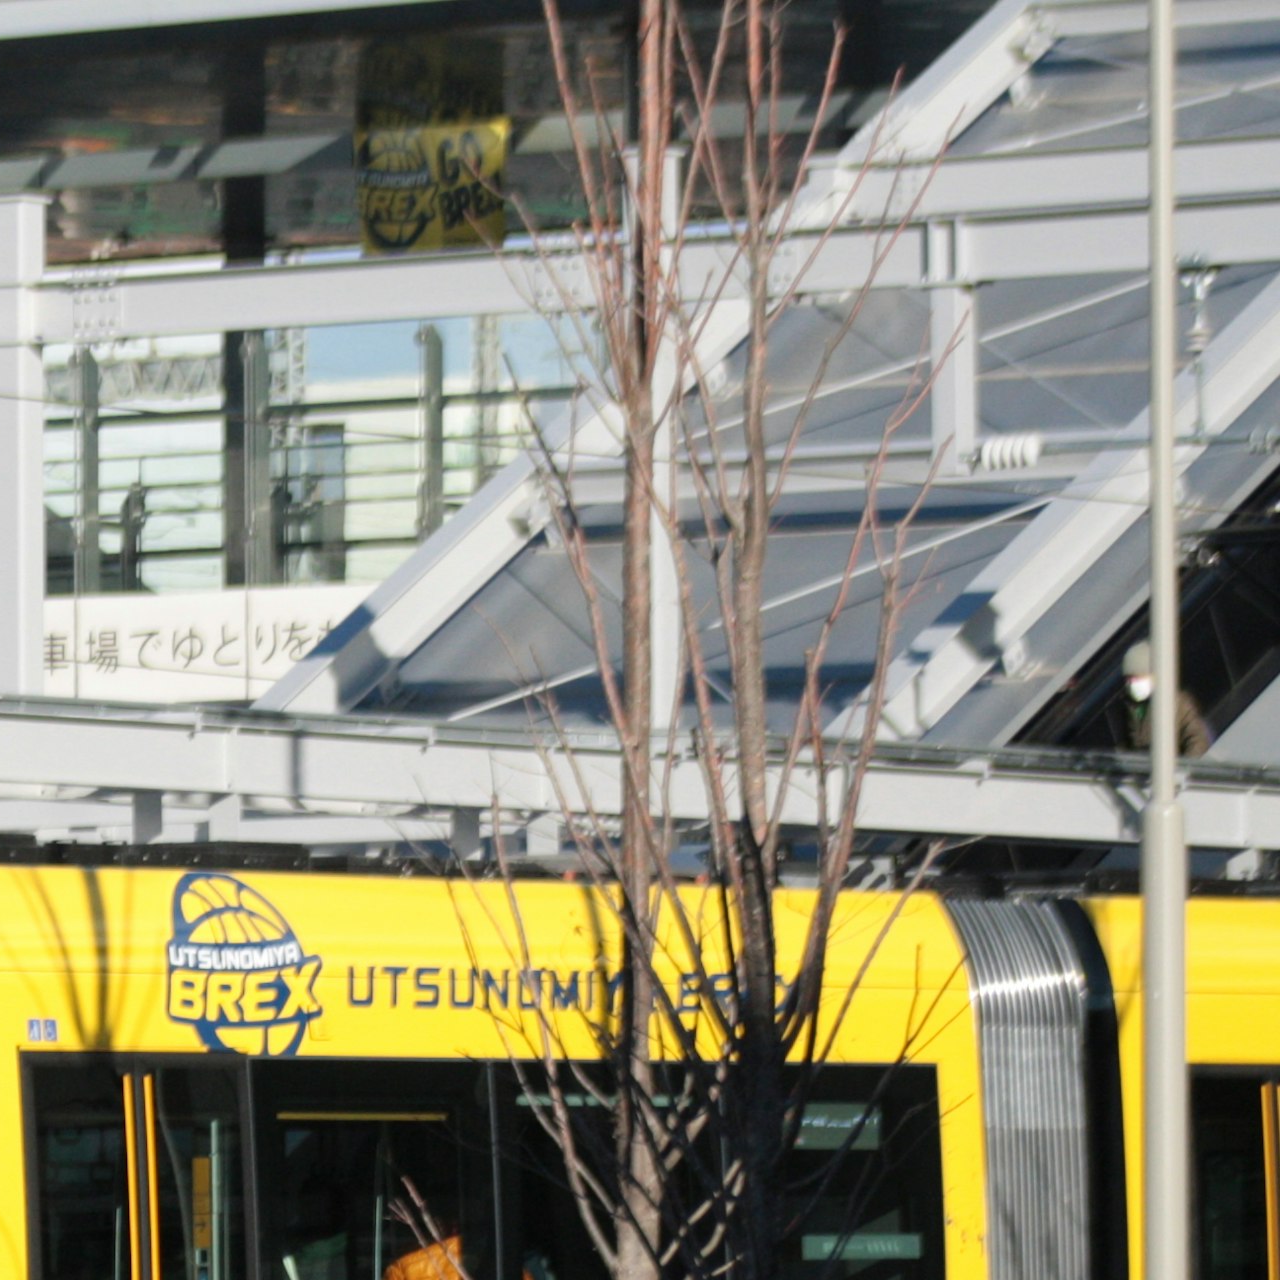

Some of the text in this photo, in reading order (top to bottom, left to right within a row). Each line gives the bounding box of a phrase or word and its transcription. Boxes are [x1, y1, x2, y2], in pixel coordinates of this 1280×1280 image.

[168, 941, 303, 971] UTSUNOMIYA
[168, 960, 322, 1024] BREX
[348, 966, 659, 1010] UTSUNOMIY
